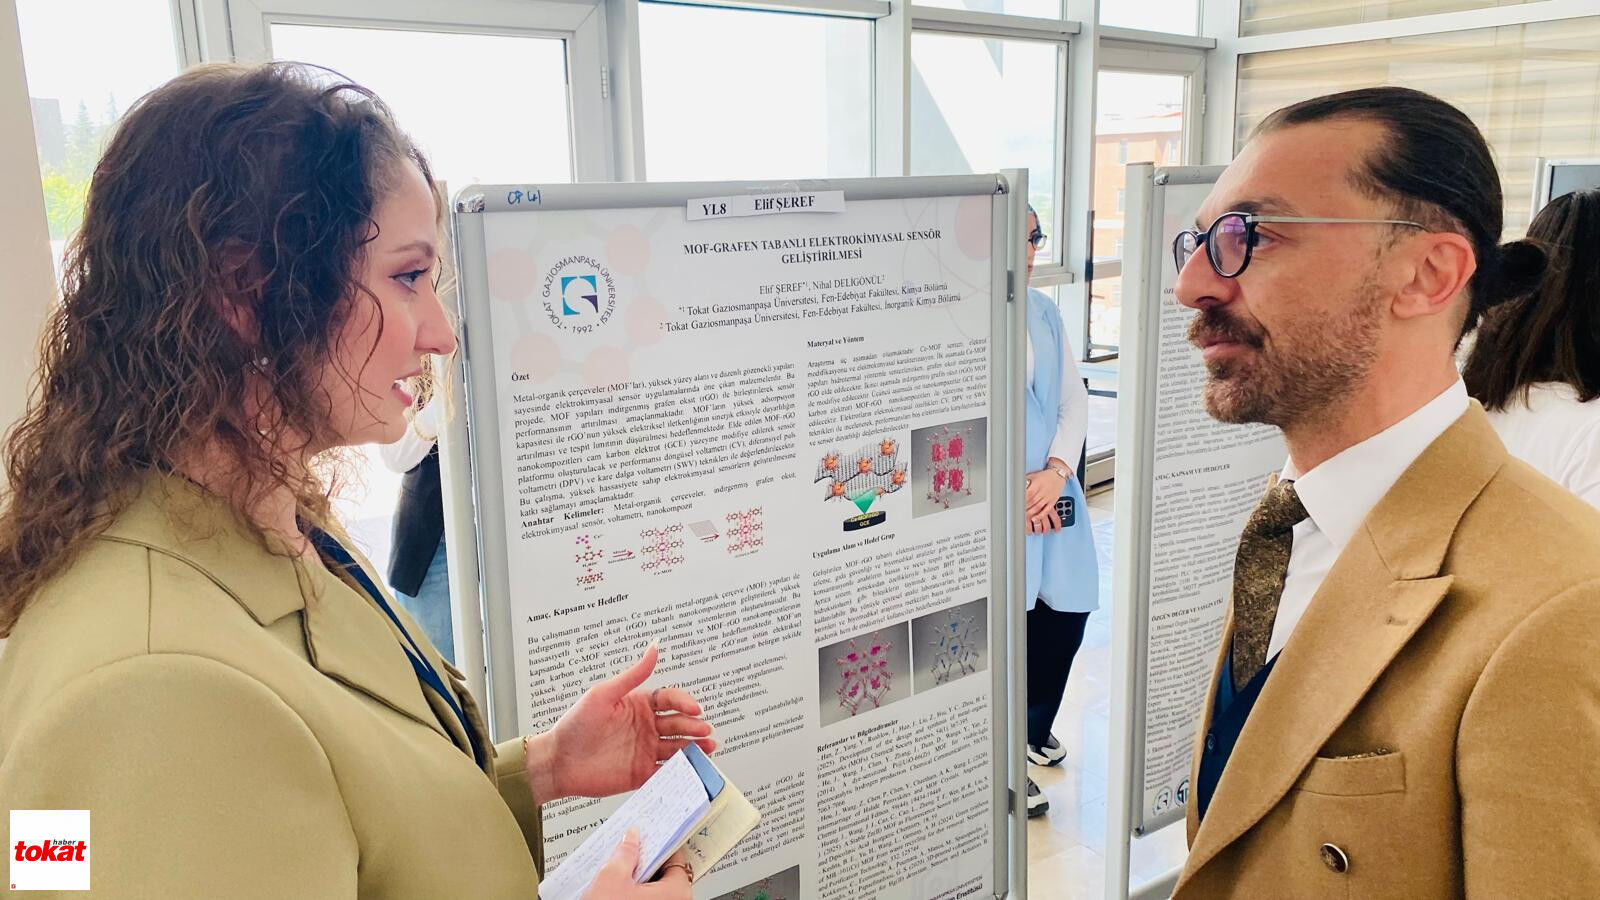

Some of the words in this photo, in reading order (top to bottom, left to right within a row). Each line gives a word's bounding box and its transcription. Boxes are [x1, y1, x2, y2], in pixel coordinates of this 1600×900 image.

[703, 204, 726, 215] YL8
[755, 198, 775, 210] Elif
[776, 196, 815, 212] ŞEREF
[684, 241, 758, 255] MOF-GRAFEN
[760, 239, 806, 250] TABANLI
[809, 233, 905, 247] ELEKTROKİMYASAL
[906, 230, 942, 240] SENSÖR
[781, 250, 863, 265] GELİŞTİRİLMESİ
[760, 285, 775, 294] Elif
[813, 280, 832, 289] Nihal
[542, 302, 562, 329] TOKAT
[572, 324, 592, 334] 1992
[512, 372, 530, 382] Özet
[551, 412, 570, 421] MOF
[606, 449, 630, 458] karbon
[664, 439, 686, 451] (GCE)
[559, 477, 584, 489] (DPV)
[674, 459, 697, 470] (SWV)
[521, 516, 554, 528] Anahtar
[564, 508, 604, 520] Kelimeler:
[527, 613, 551, 623] Amaç,
[554, 604, 584, 618] Kapsam
[598, 594, 629, 607] Hedefler
[550, 672, 574, 682] karbon
[610, 654, 632, 668] (GCE)
[566, 824, 587, 836] Değer
[546, 851, 567, 863] eryum
